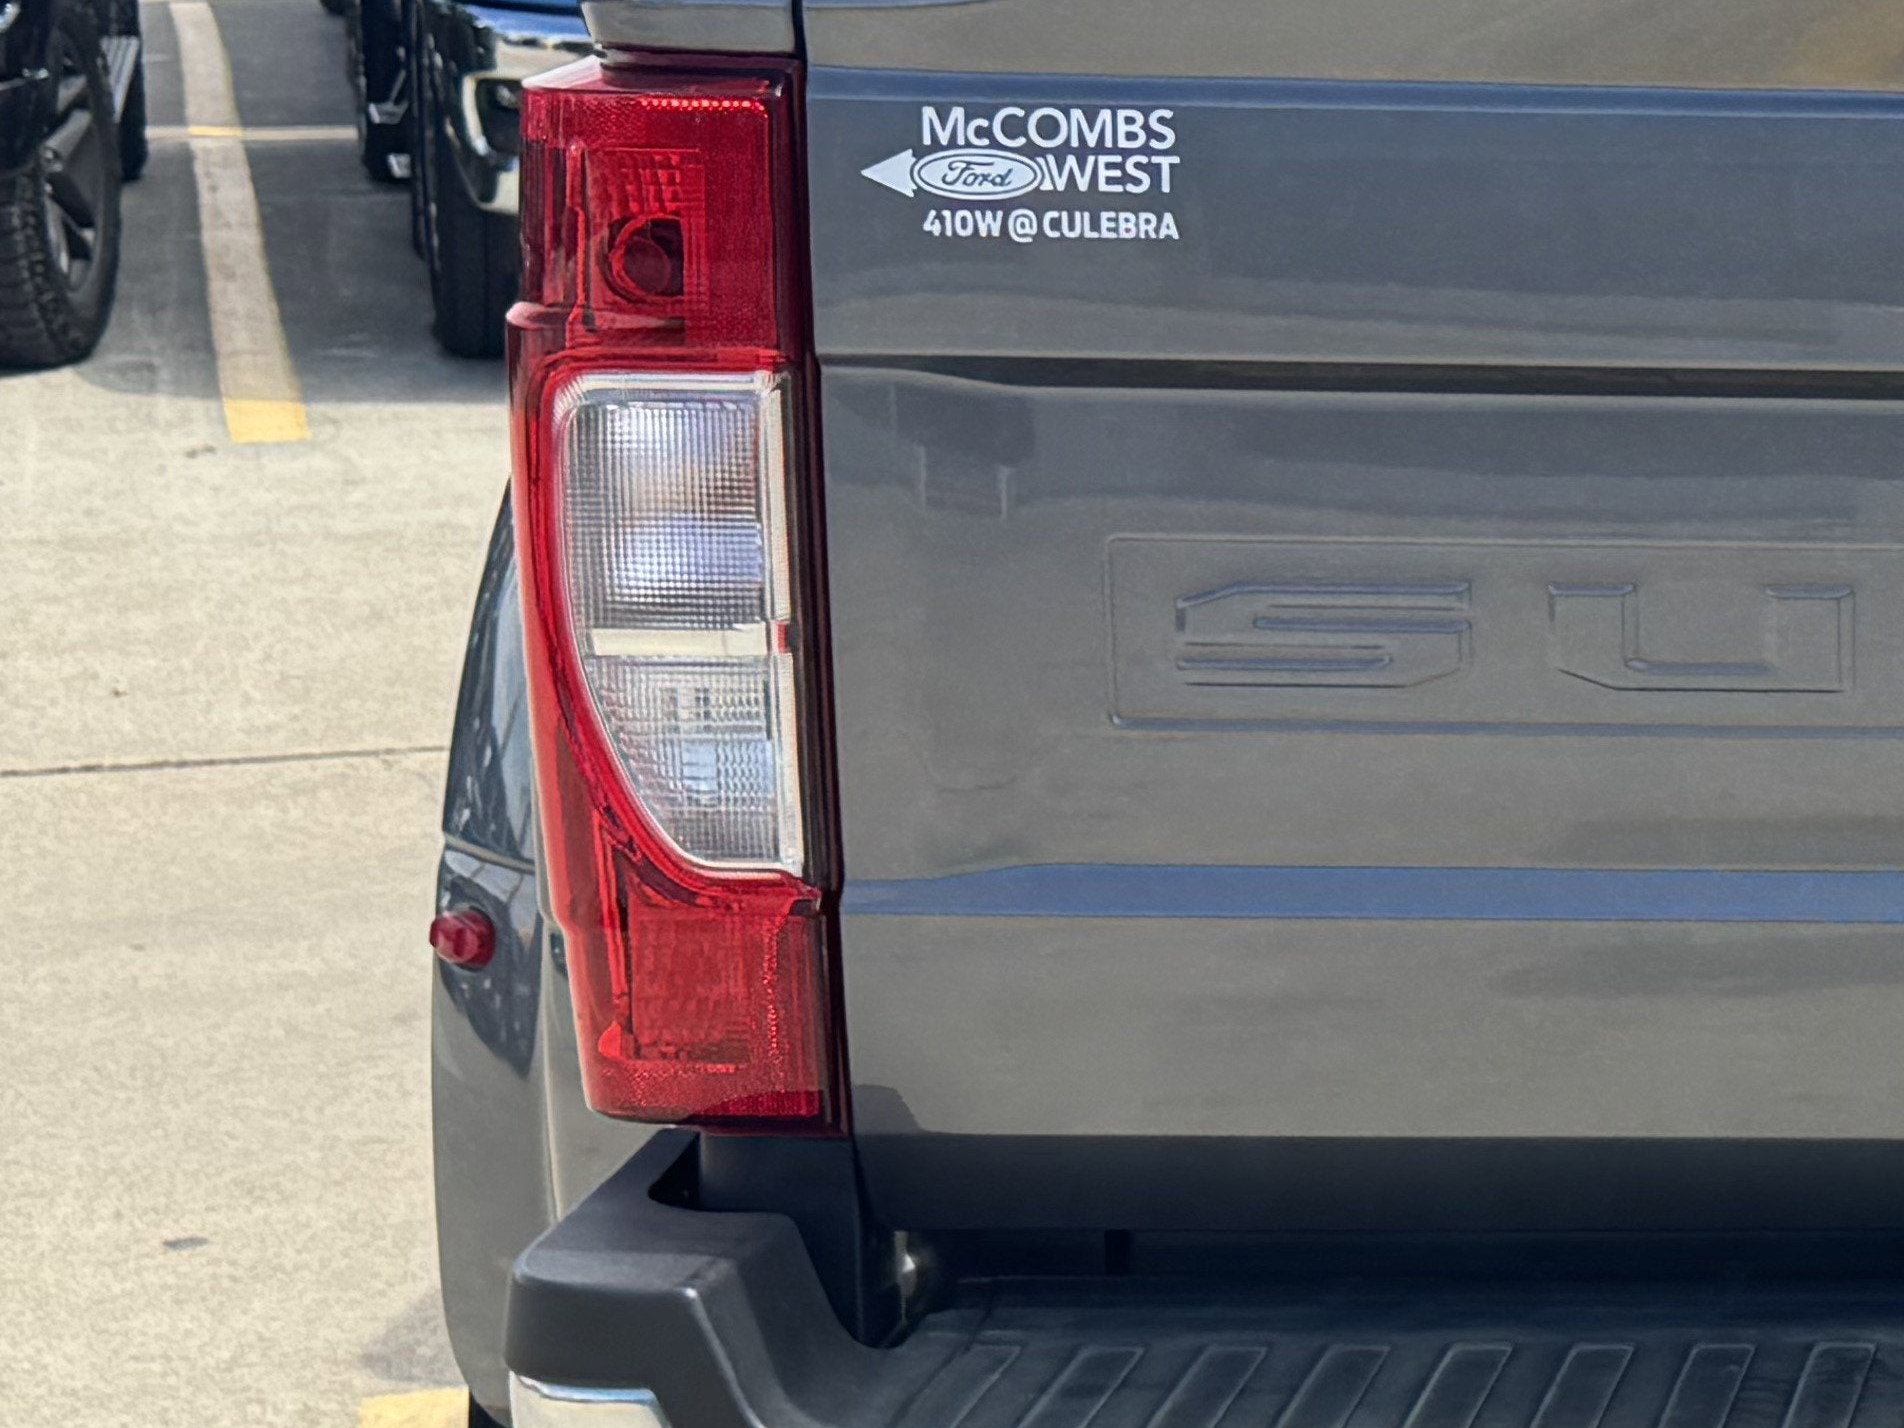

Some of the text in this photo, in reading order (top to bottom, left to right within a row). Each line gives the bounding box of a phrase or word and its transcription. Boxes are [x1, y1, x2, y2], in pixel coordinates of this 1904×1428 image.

[922, 106, 1177, 150] McCOMBS
[941, 155, 1181, 194] Ford WEST
[922, 208, 1003, 238] 410W
[1043, 210, 1180, 240] CULEBRA
